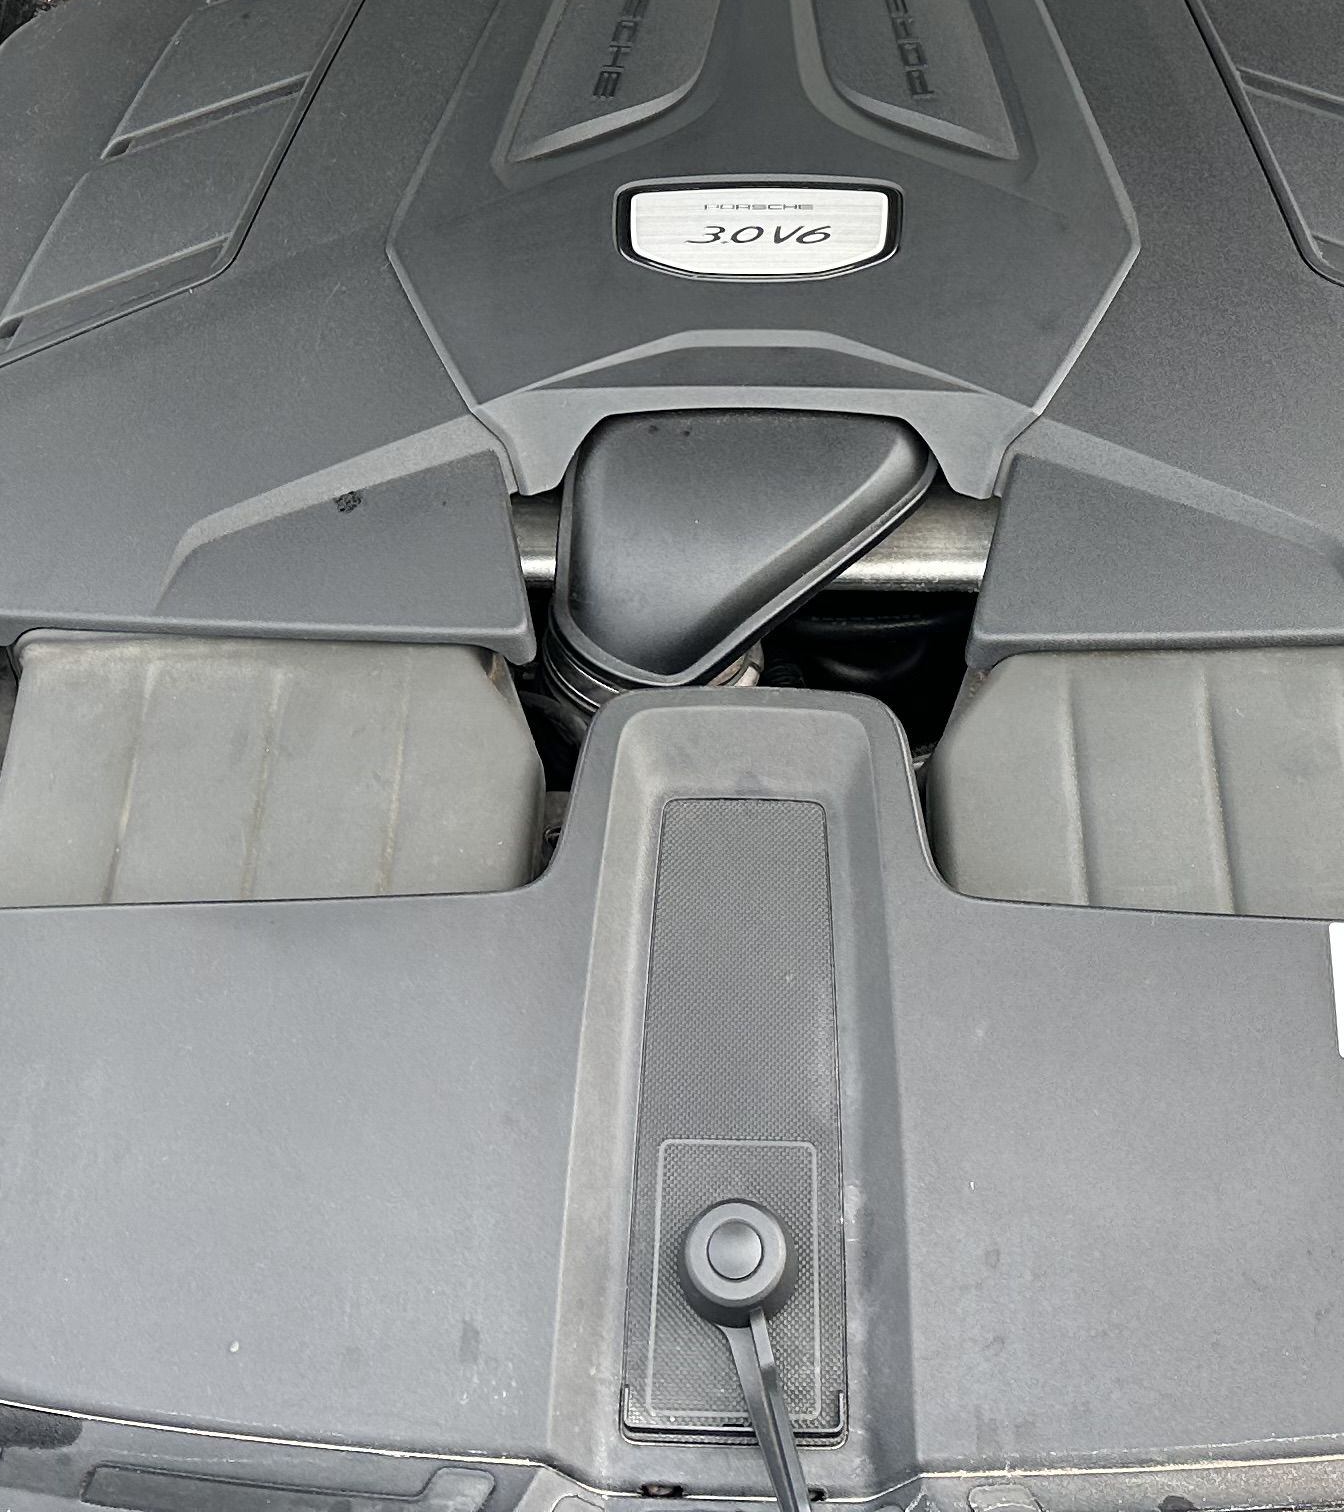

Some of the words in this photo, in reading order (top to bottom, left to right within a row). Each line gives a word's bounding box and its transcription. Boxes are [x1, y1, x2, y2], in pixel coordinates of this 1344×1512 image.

[704, 203, 814, 211] PORSCHE
[685, 225, 764, 244] 3.0
[773, 225, 832, 244] V6
